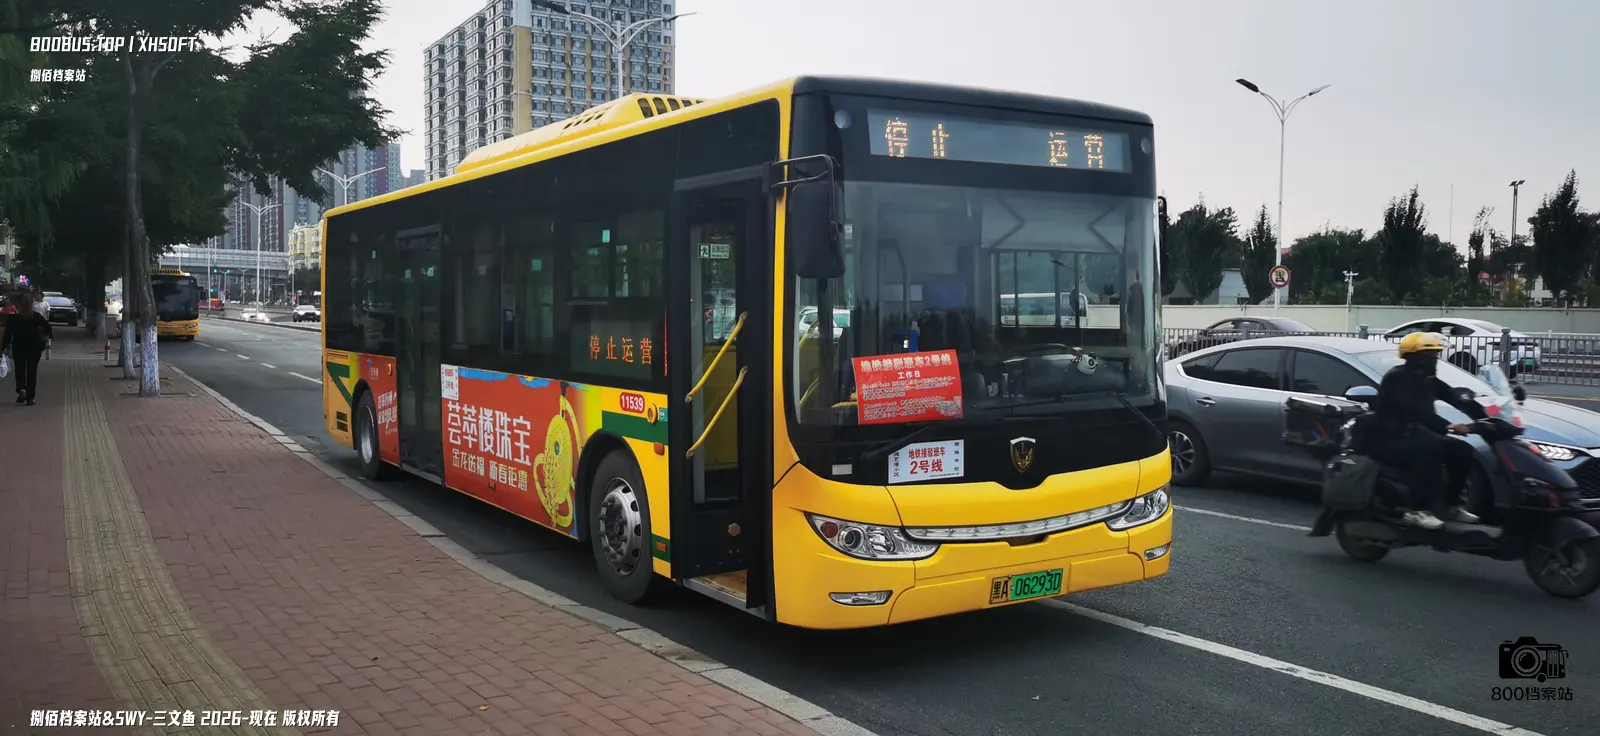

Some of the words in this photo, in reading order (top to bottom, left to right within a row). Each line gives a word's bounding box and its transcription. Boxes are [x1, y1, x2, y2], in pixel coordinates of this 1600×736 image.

[884, 117, 950, 158] 停止
[589, 335, 653, 365] 停止运营
[897, 371, 921, 379] 工作日
[621, 395, 644, 411] 11539
[447, 401, 532, 466] 荟萃楼珠宝
[452, 448, 485, 476] 金龙送福
[908, 447, 946, 459] 地铁接驳班车
[909, 459, 943, 475] 2号线
